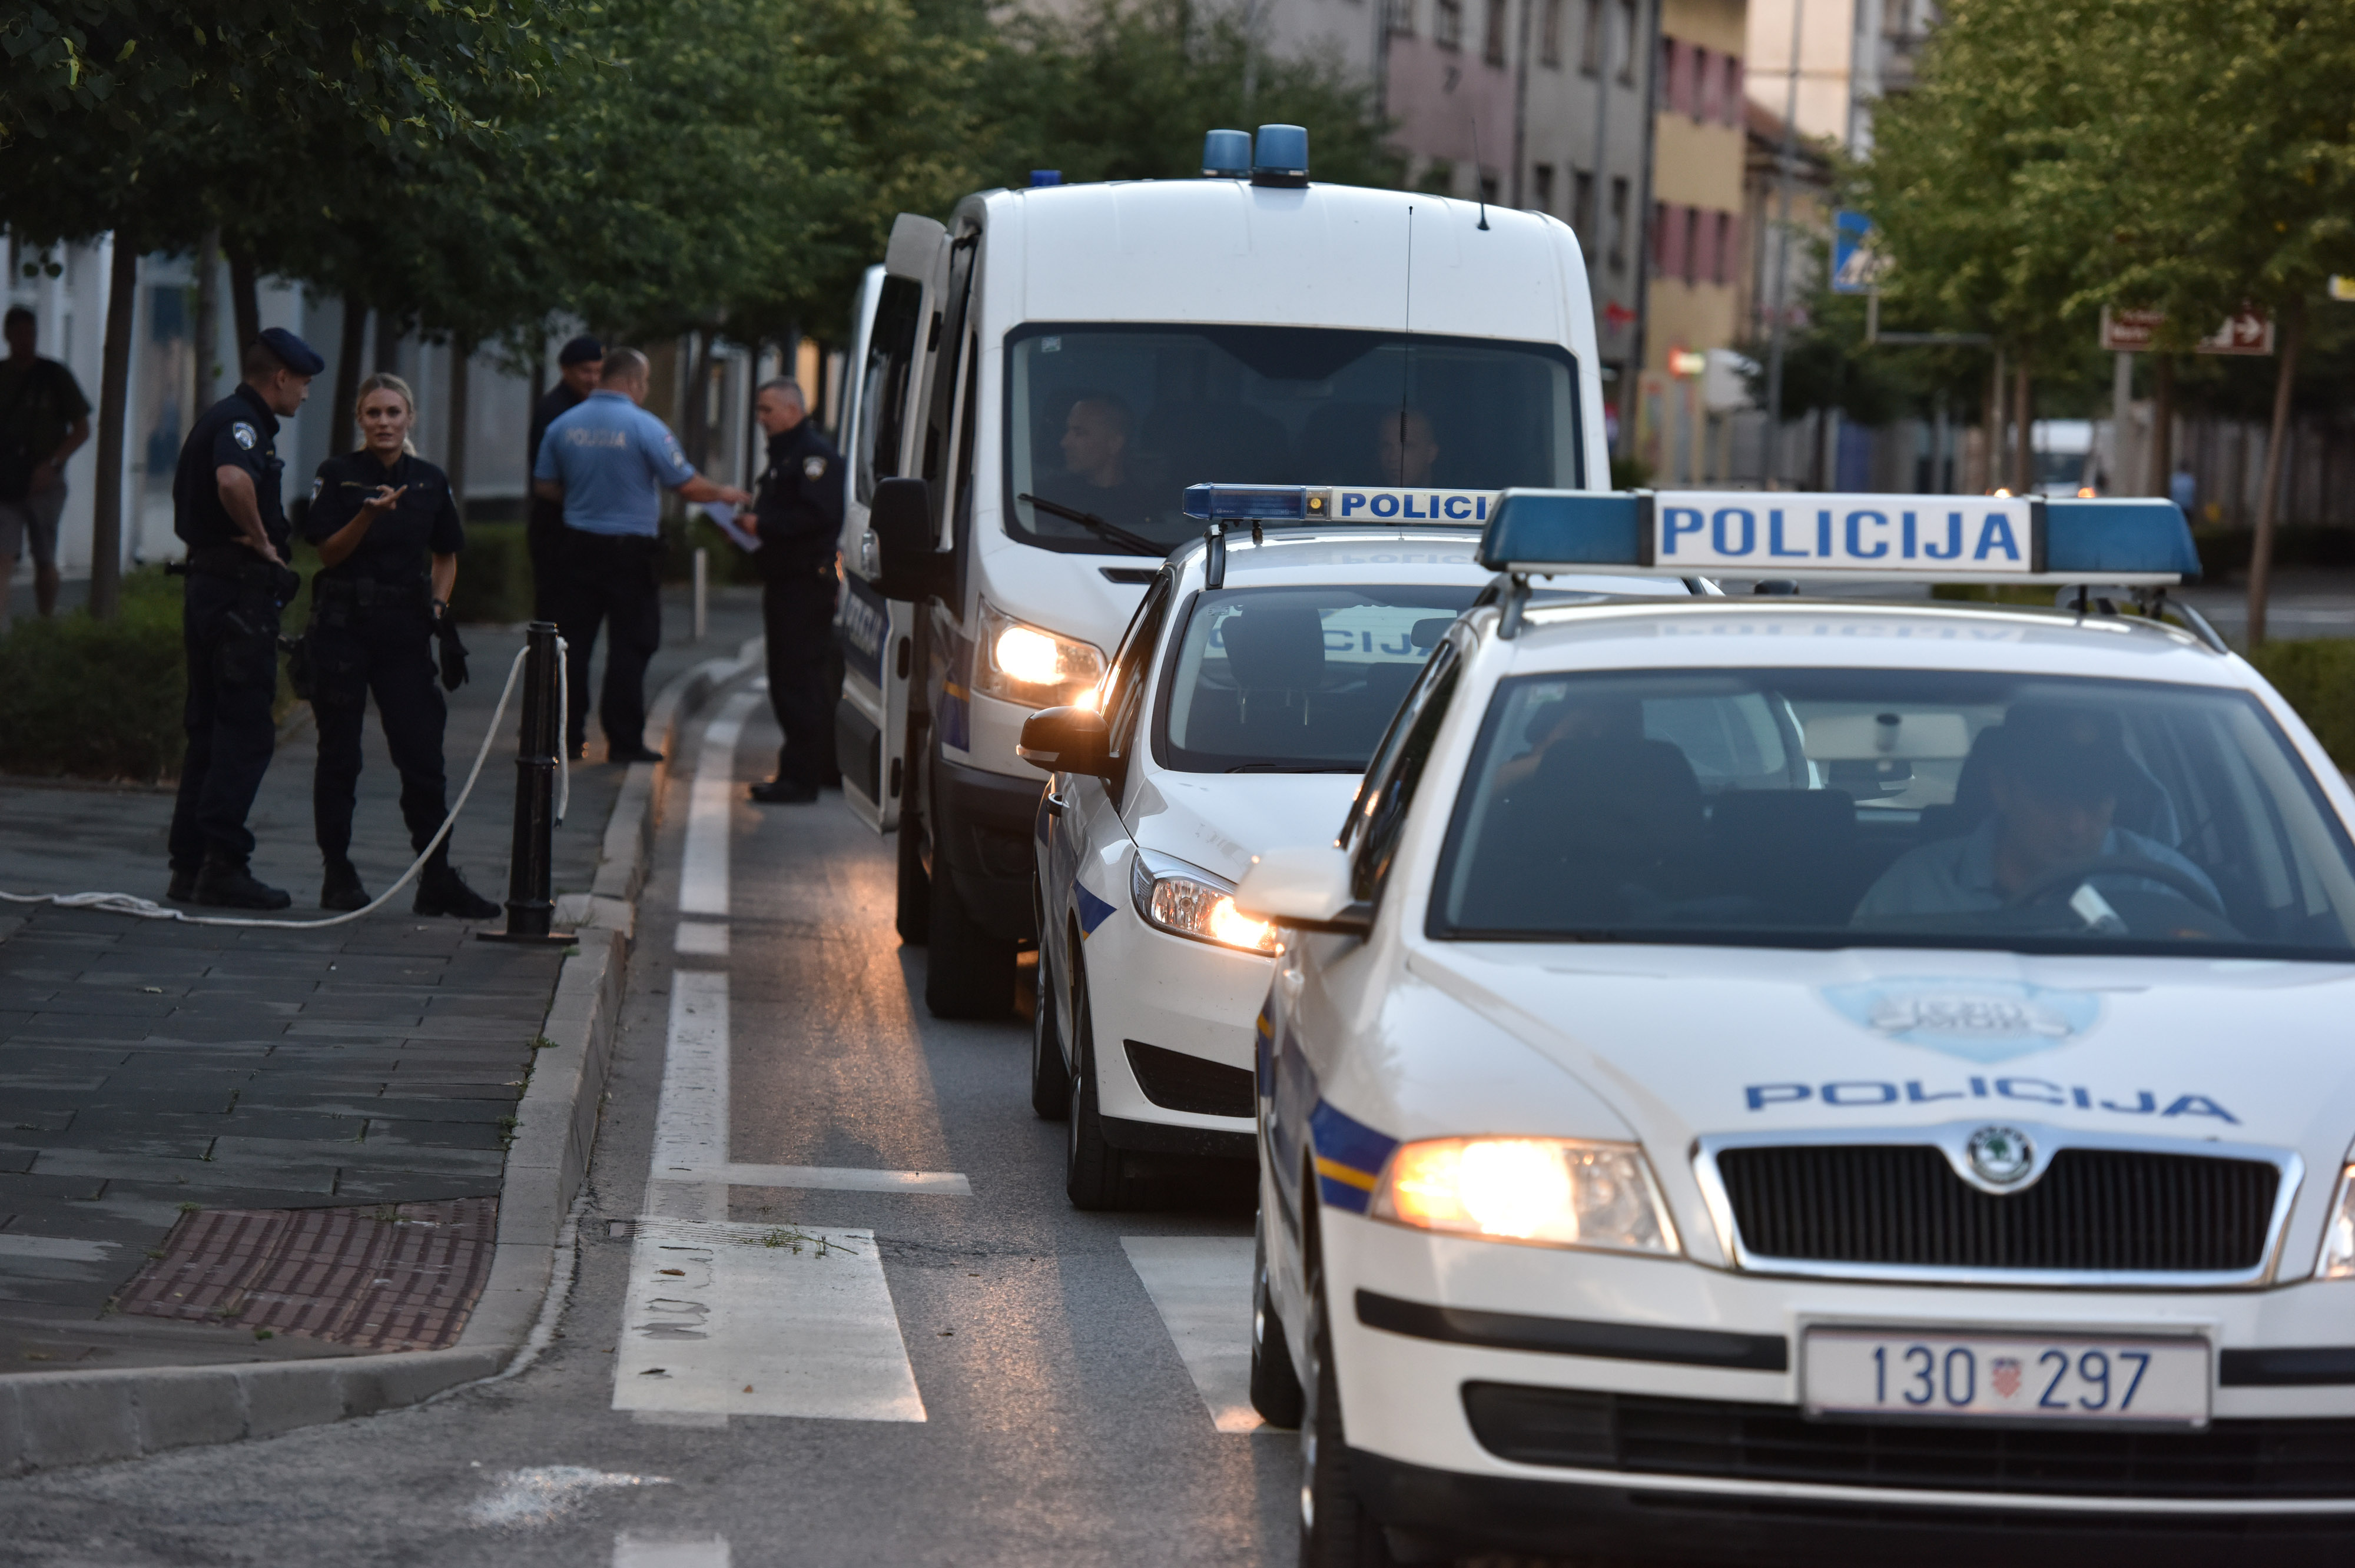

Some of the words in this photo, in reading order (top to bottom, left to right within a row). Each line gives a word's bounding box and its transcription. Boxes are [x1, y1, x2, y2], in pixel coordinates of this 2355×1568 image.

[1342, 493, 1486, 520] POLICI
[1661, 507, 2022, 561] POLICIJA
[1744, 1077, 2242, 1125] POLICIJA
[1875, 1346, 1977, 1406] 130
[2039, 1350, 2152, 1411] 297
